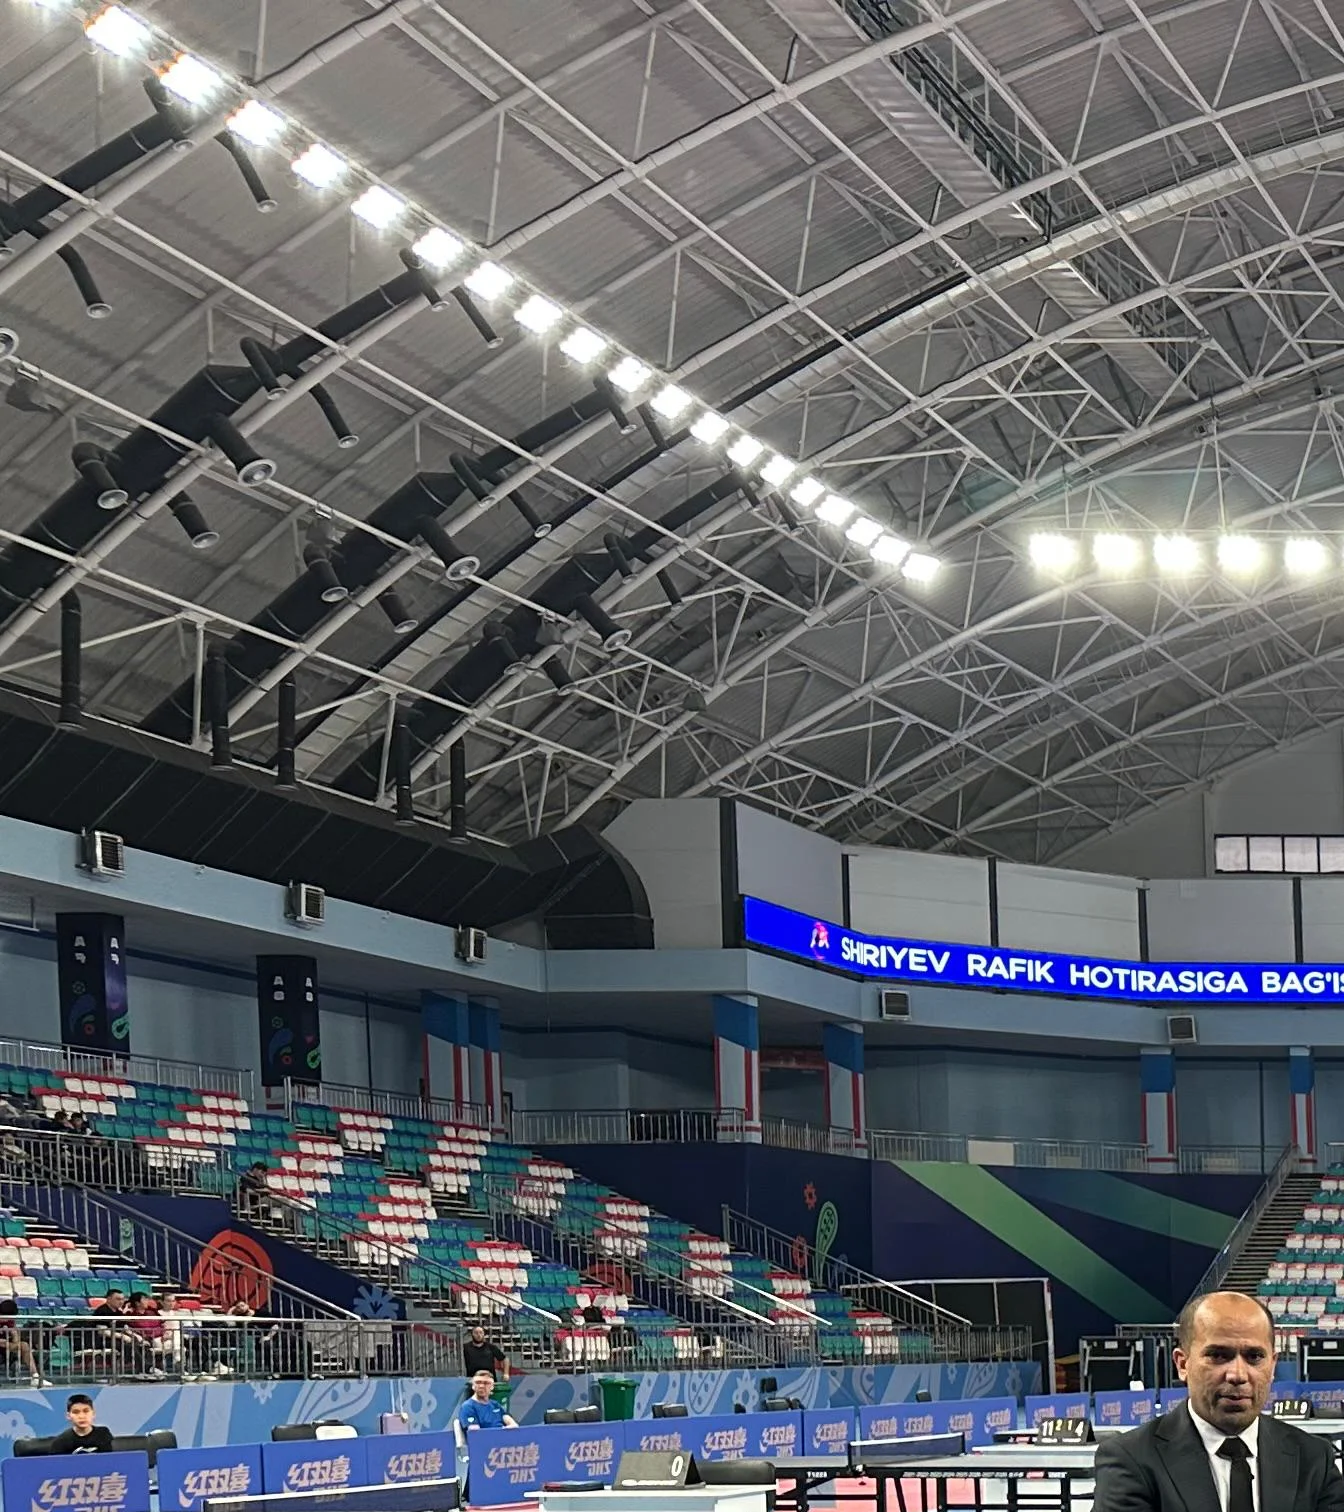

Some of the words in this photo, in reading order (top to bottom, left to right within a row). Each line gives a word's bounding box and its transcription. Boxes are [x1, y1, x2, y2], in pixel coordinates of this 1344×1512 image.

[841, 936, 950, 974] SHIRIYEV
[967, 954, 1054, 984] RAFIK
[1070, 965, 1249, 994] HOTIRASIGA
[1041, 1420, 1054, 1436] 11
[1055, 1419, 1062, 1431] 2
[1067, 1419, 1073, 1431] 1
[1074, 1421, 1084, 1437] 4
[509, 1467, 538, 1484] DHS
[586, 1460, 612, 1477] DHS
[670, 1455, 684, 1477] 0
[178, 1463, 251, 1508] 红双喜
